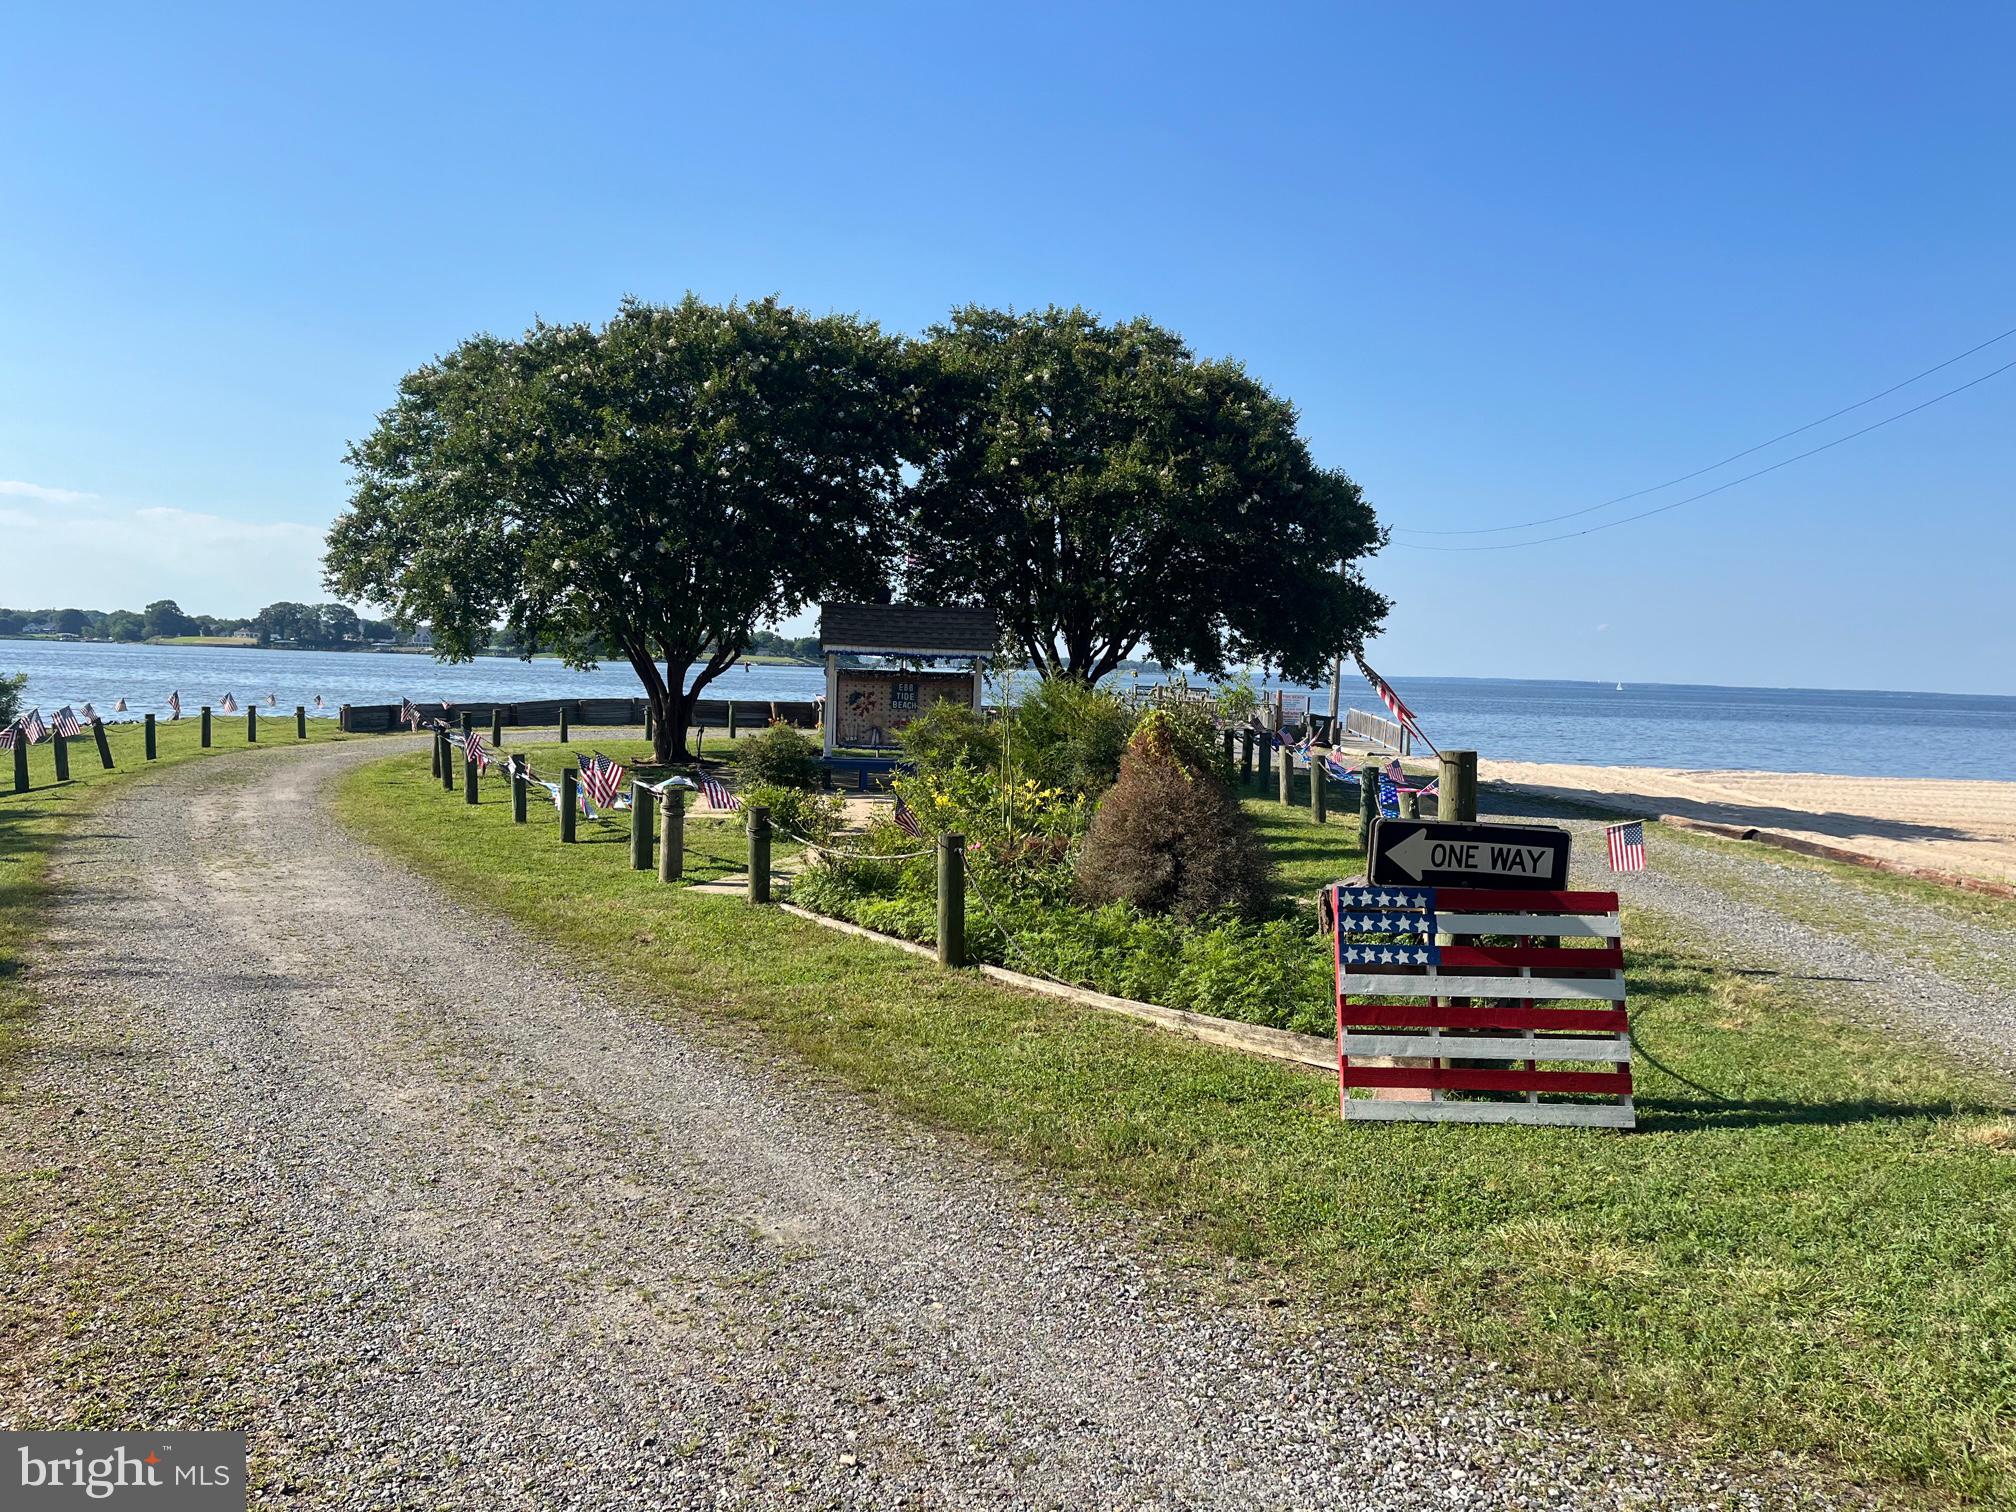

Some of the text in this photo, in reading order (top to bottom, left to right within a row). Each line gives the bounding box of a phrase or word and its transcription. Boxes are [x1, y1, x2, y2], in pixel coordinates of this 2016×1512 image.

[896, 692, 915, 701] TIDE
[892, 700, 917, 709] BEACH
[1430, 843, 1546, 873] ONE WAY
